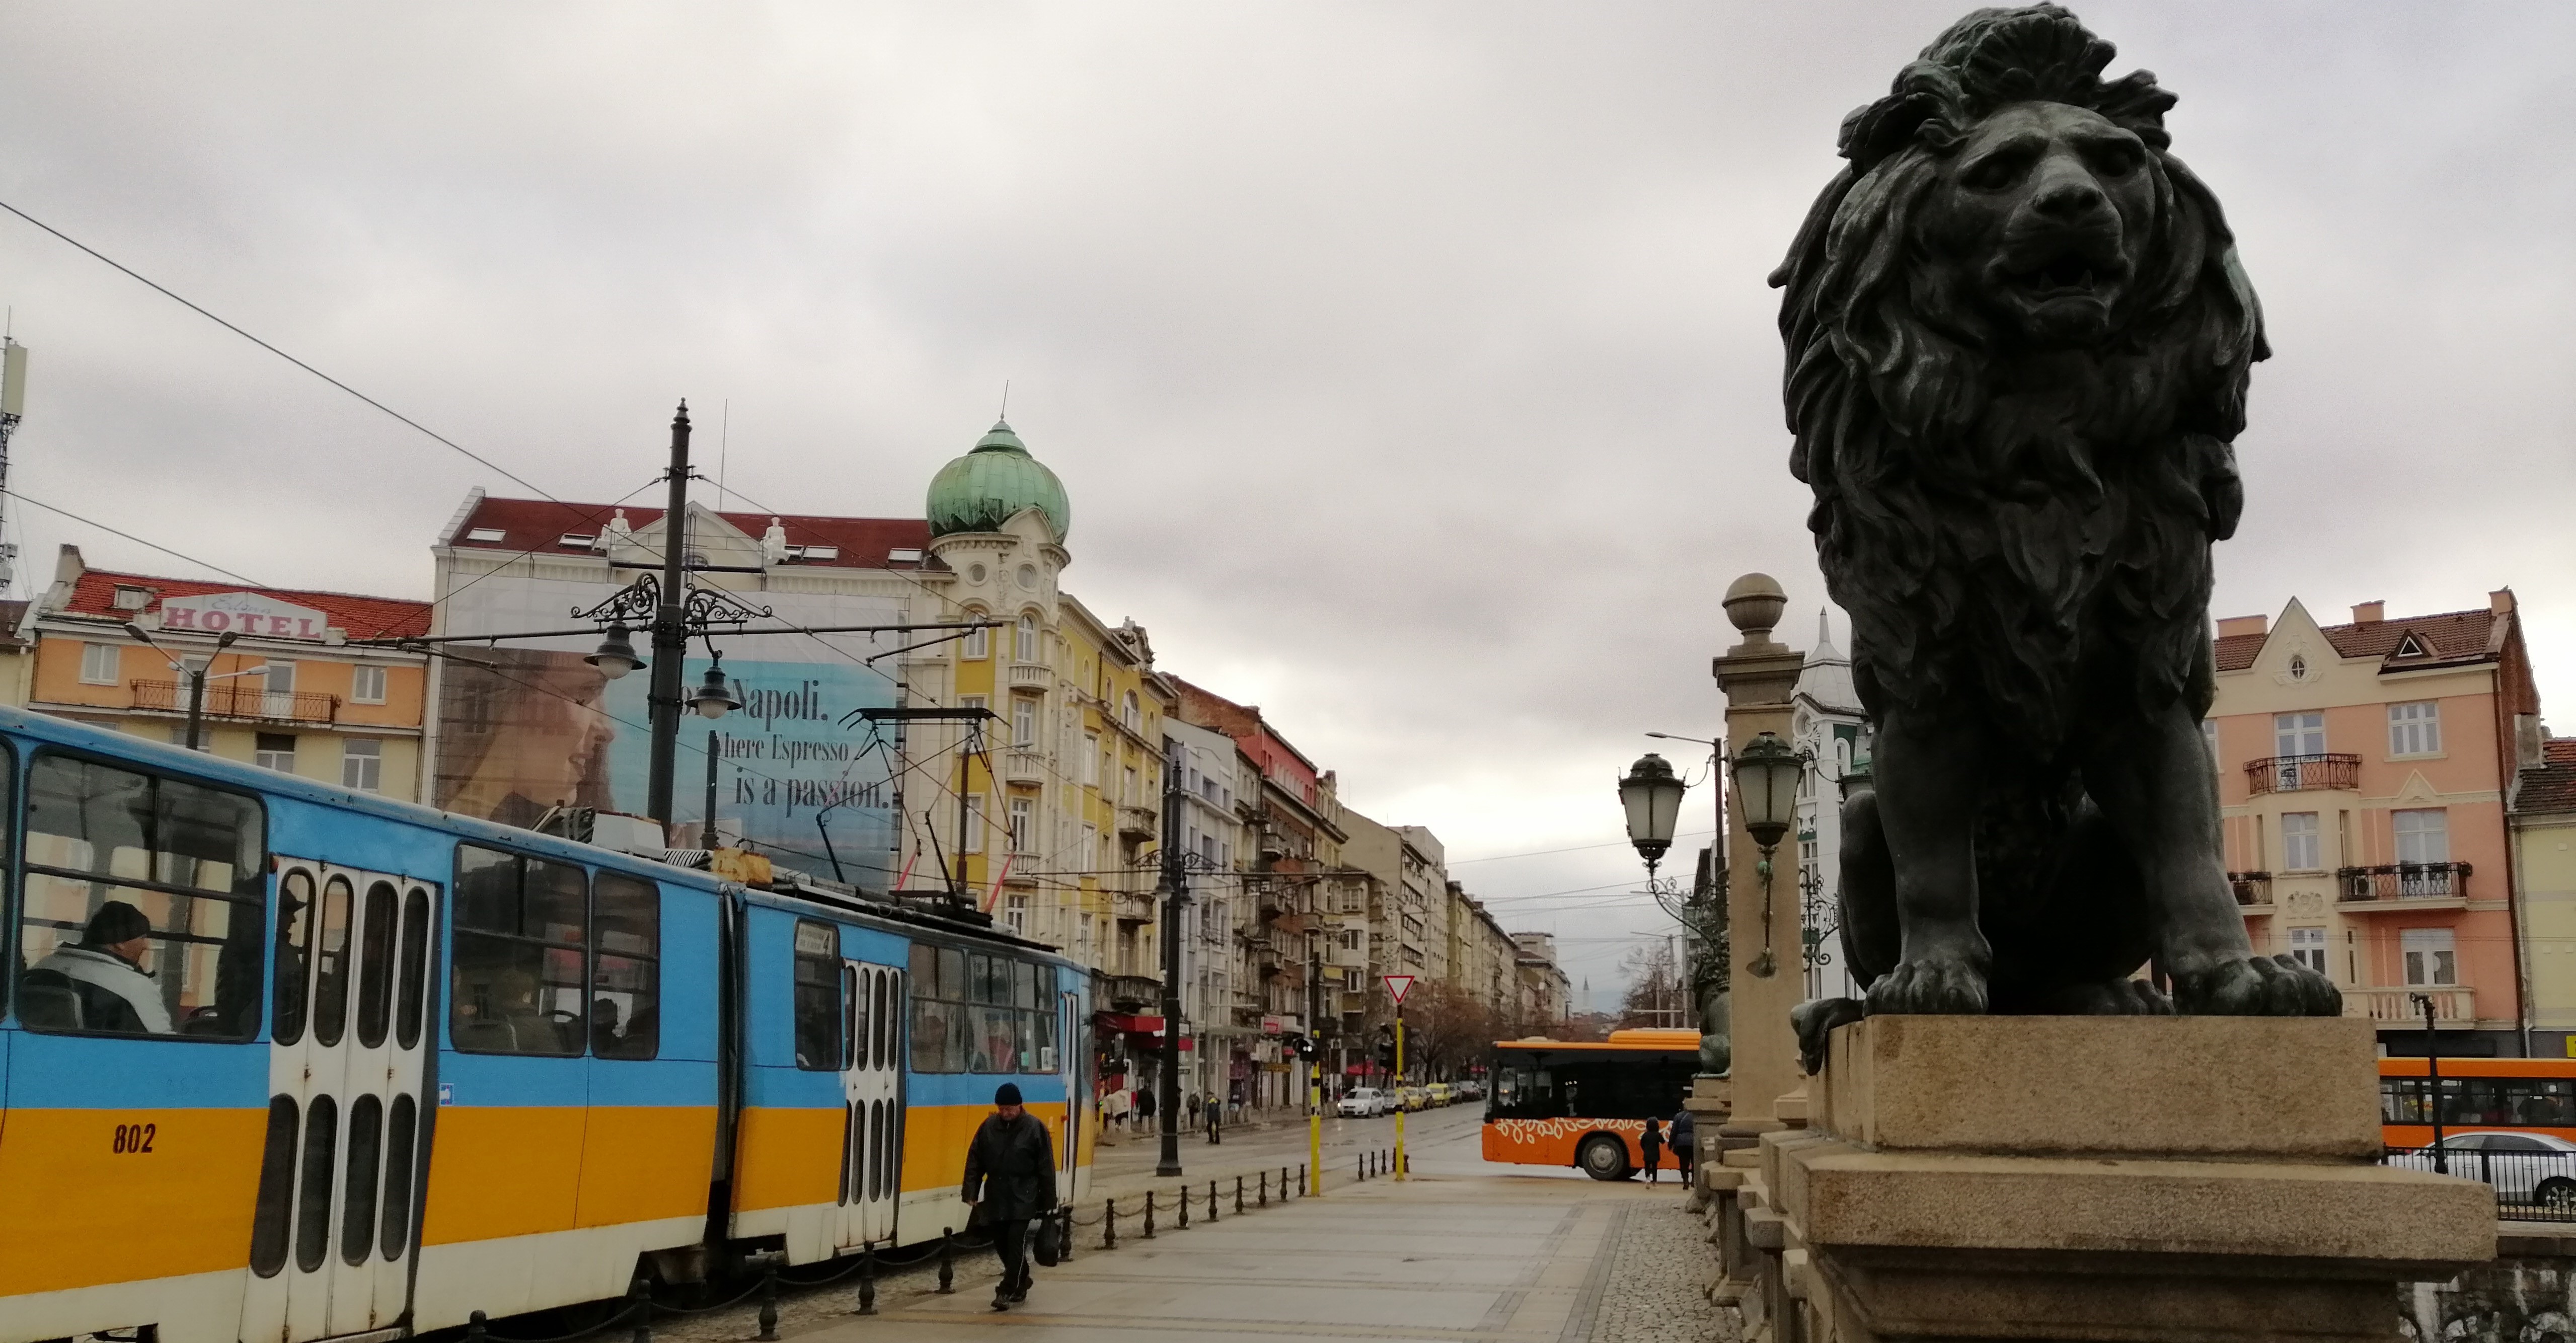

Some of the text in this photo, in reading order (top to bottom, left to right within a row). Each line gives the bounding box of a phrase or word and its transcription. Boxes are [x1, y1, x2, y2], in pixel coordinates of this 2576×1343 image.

[164, 607, 321, 639] HOTEL
[730, 679, 828, 732] Napoli,
[717, 731, 849, 769] here Espresso
[735, 766, 889, 818] is a passion.
[112, 1123, 156, 1154] 802
